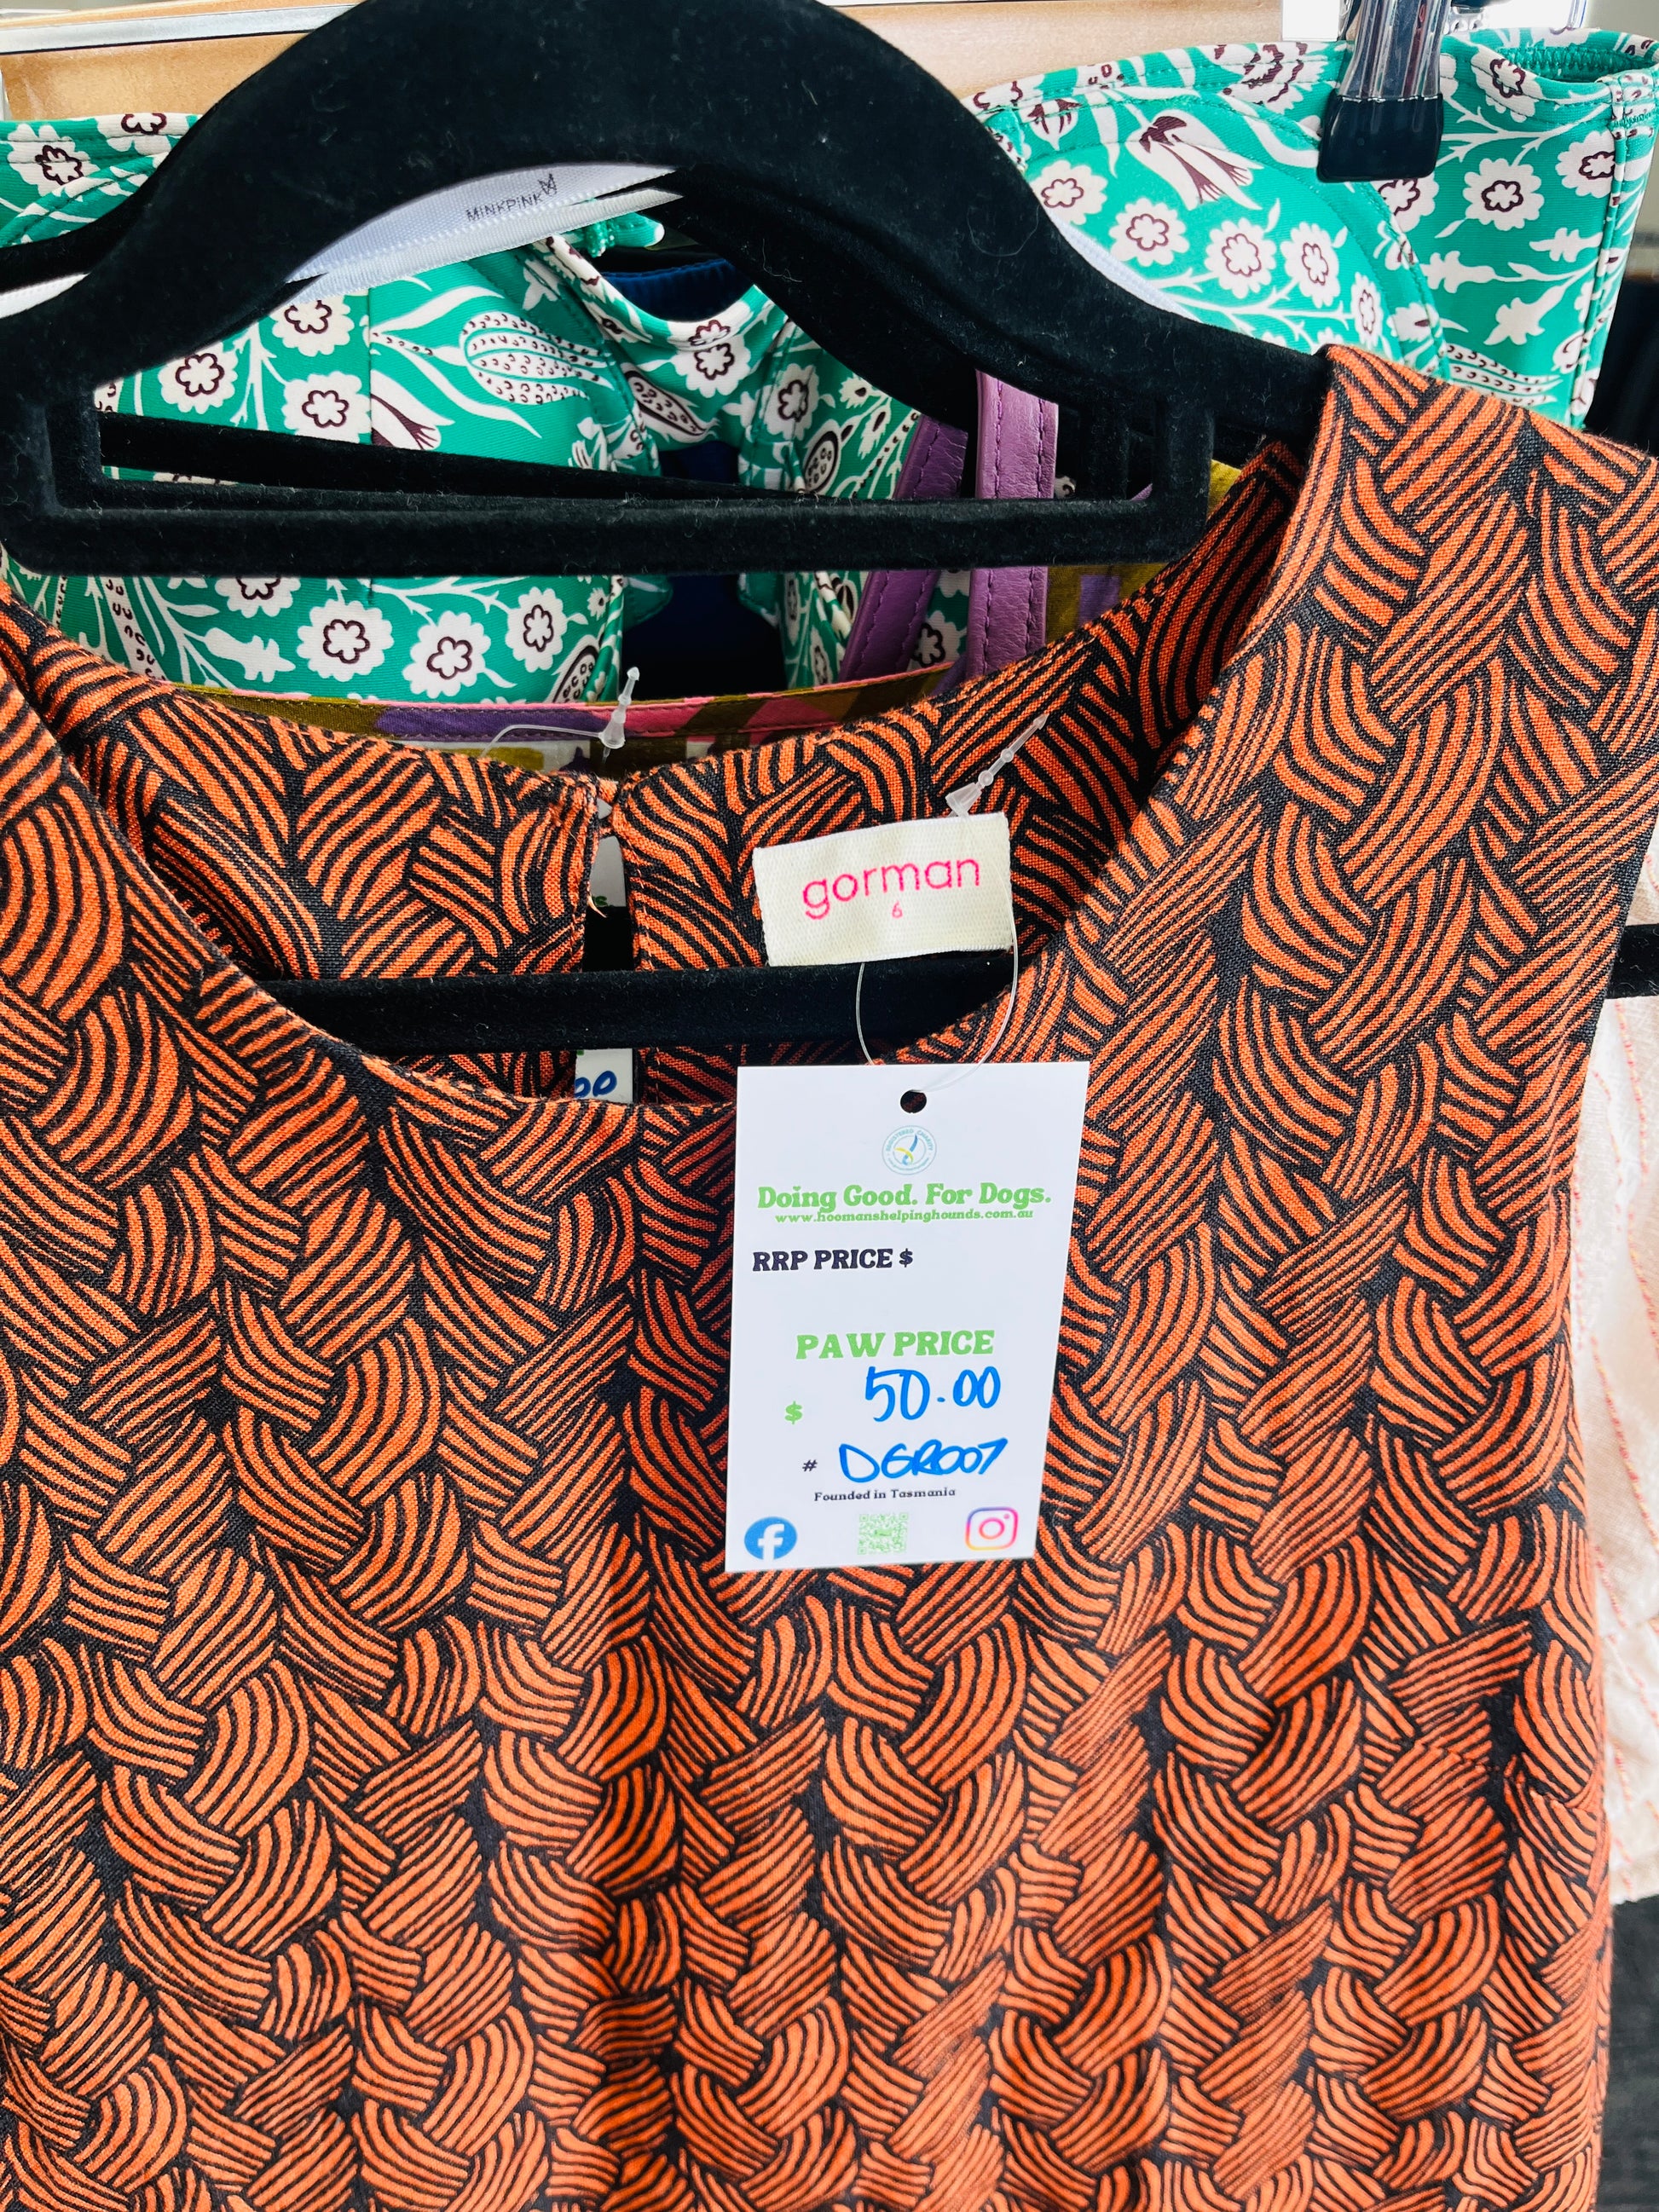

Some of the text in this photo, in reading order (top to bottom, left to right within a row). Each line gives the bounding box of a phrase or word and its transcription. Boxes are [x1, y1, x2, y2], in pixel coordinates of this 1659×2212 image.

[802, 858, 980, 920] gorman
[892, 900, 903, 918] 6
[757, 1182, 1052, 1212] Doing Good. For Dogs.
[775, 1210, 1034, 1223] www.hoomanshelpinghounds.com.au
[753, 1247, 914, 1272] RRP PRICE $
[795, 1330, 995, 1360] PAW PRICE
[864, 1366, 1001, 1423] 50.00
[784, 1401, 803, 1424] $
[802, 1459, 818, 1472] #
[814, 1487, 956, 1502] Founded in Tasmania
